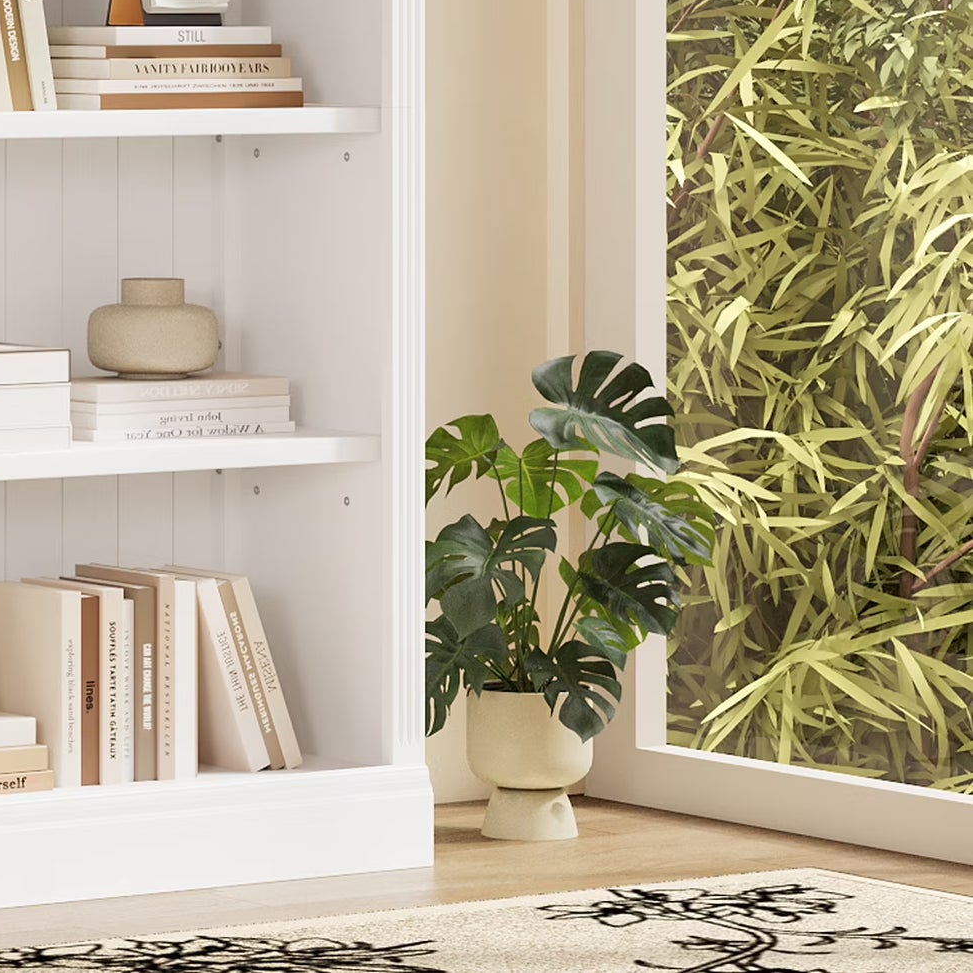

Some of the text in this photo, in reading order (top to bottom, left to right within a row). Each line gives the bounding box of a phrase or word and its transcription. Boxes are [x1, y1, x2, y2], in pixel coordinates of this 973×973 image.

[8, 30, 20, 61] DESIGN
[178, 30, 206, 42] STILL
[135, 64, 177, 74] VANITY
[181, 63, 208, 73] FAIR
[229, 63, 270, 73] YEARS
[108, 622, 117, 662] SOUFFLÉS
[66, 639, 75, 677] exploring
[109, 665, 117, 691] TARTE
[85, 681, 96, 714] lines.
[109, 693, 117, 717] TATIN
